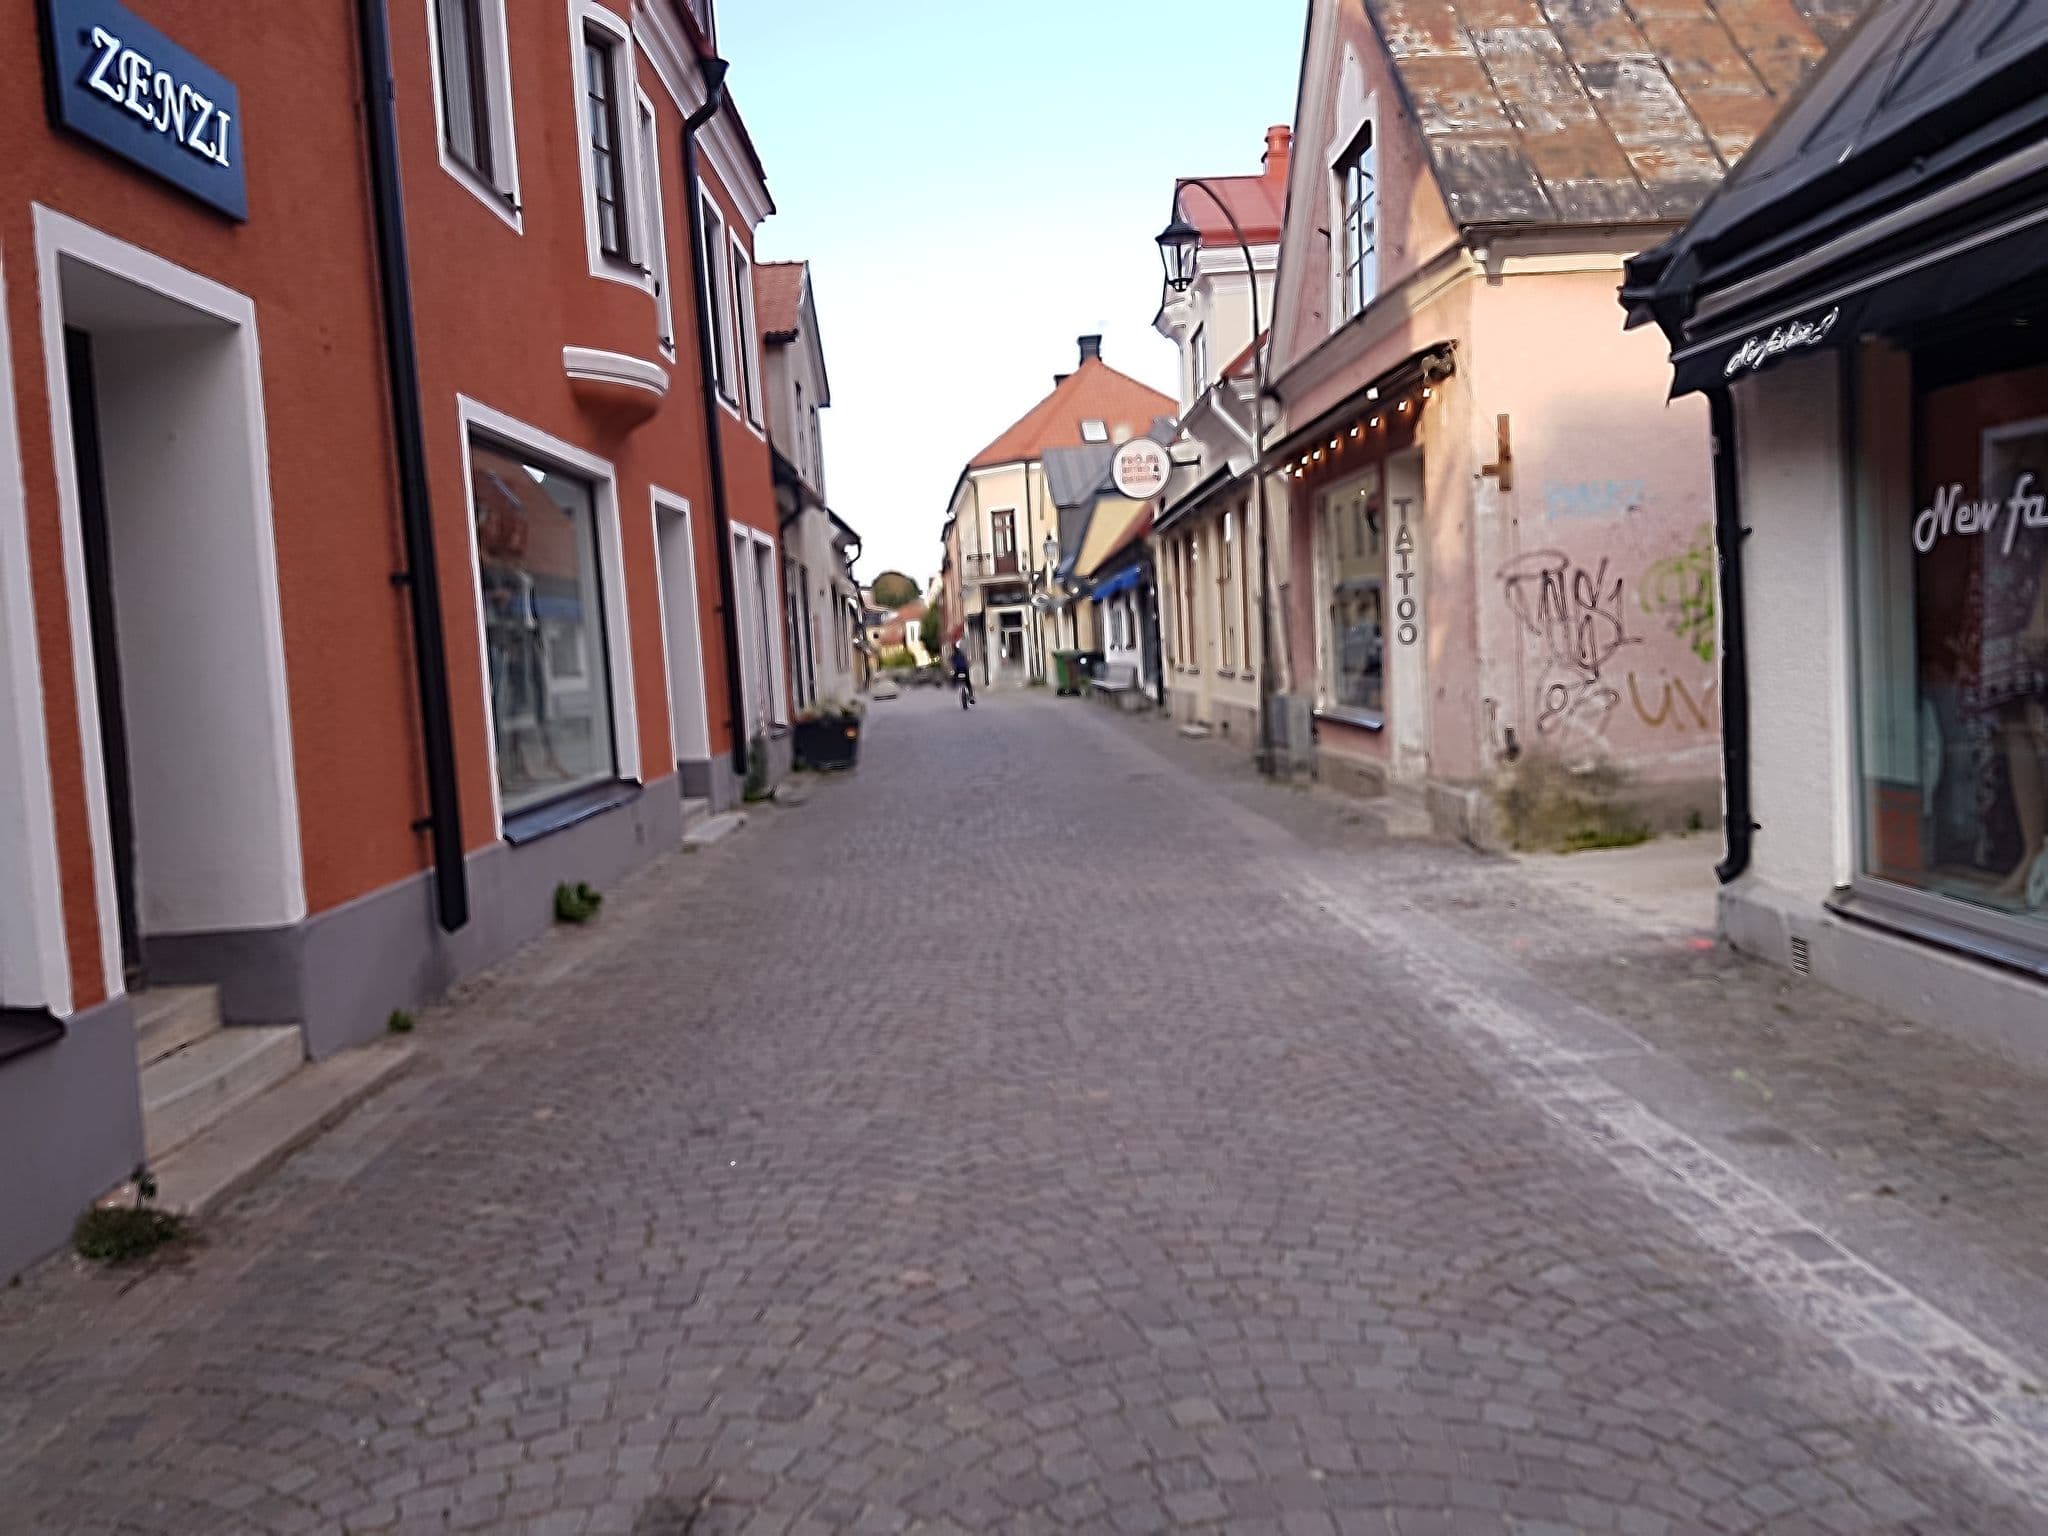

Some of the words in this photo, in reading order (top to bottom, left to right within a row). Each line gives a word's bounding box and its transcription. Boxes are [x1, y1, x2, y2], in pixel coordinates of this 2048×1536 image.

[88, 26, 231, 167] ZENZI
[1392, 498, 1418, 646] TATTOO
[1913, 483, 1999, 552] New
